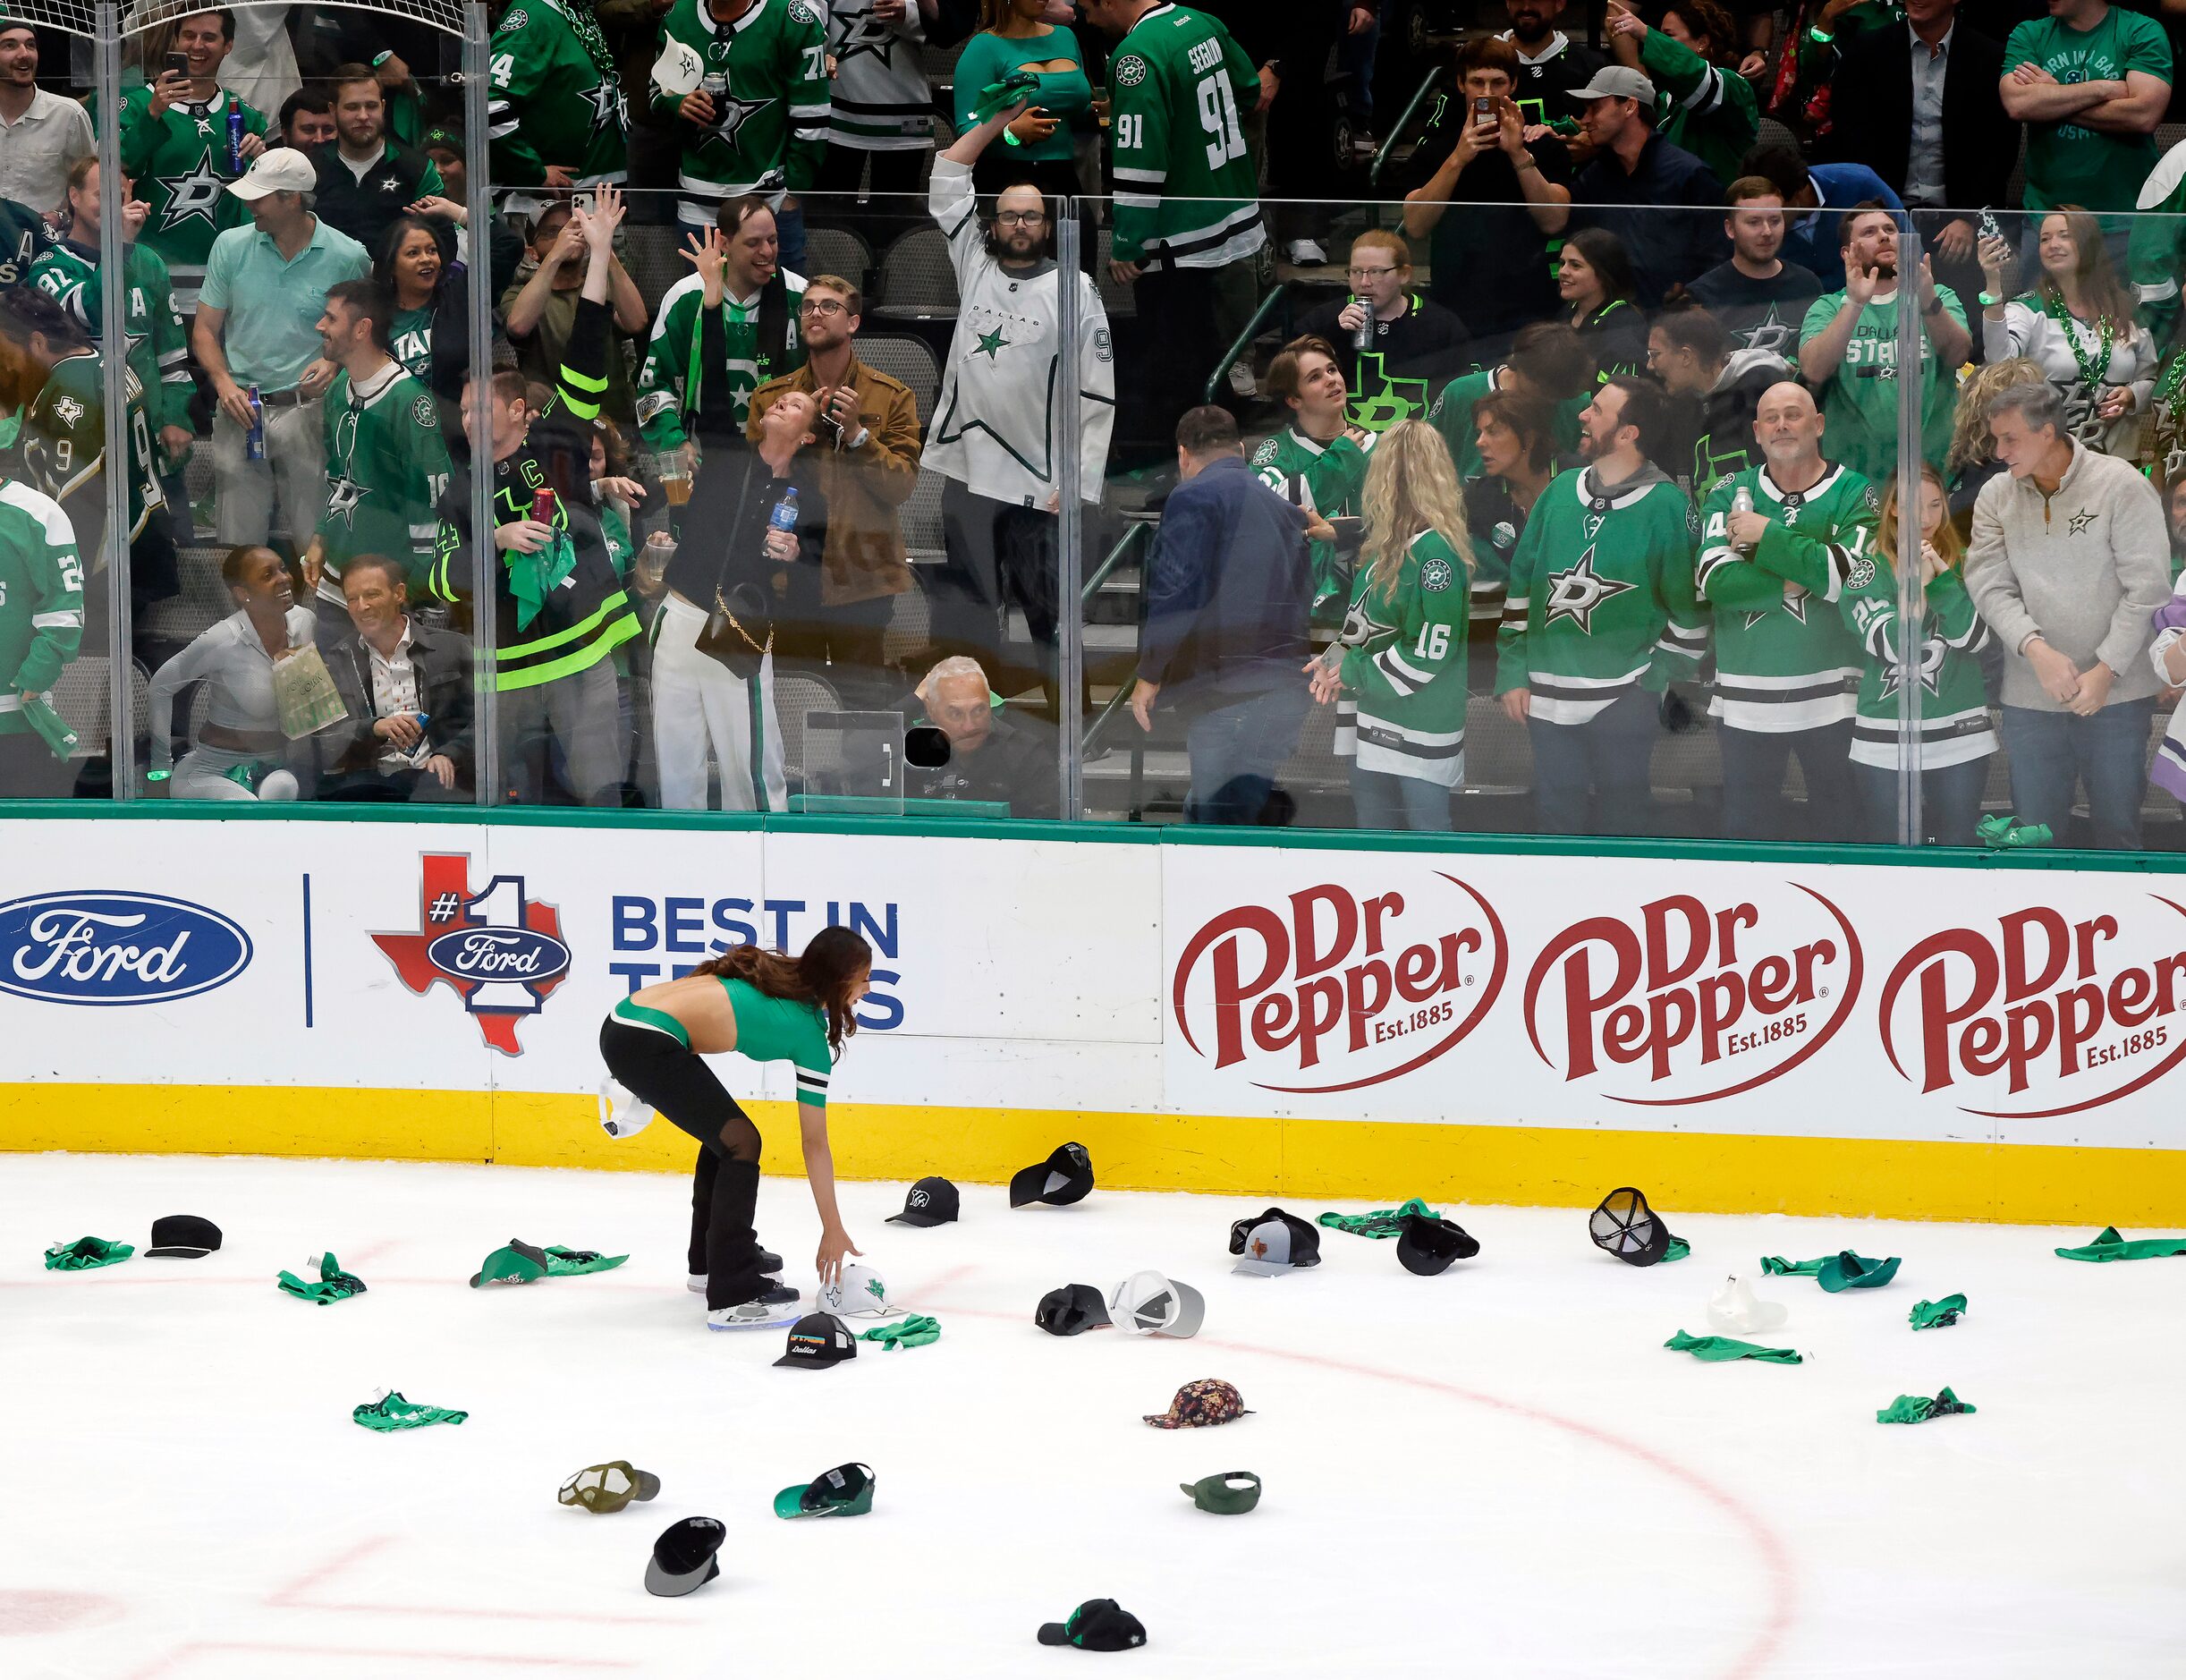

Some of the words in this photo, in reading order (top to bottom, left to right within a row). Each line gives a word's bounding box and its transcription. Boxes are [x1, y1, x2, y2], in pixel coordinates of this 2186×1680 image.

[801, 45, 827, 81] 71
[1187, 36, 1224, 75] SEGUIN
[1117, 114, 1143, 149] 91
[1197, 68, 1247, 171] 91
[2057, 124, 2099, 140] USM
[130, 287, 147, 318] A
[972, 305, 1040, 327] DALLAS
[1094, 327, 1114, 362] 9
[55, 438, 72, 472] 9
[135, 407, 165, 510] 9
[520, 459, 545, 489] C
[436, 517, 461, 553] 4
[57, 555, 85, 592] 2
[1414, 621, 1452, 660] 16
[612, 895, 806, 955] BEST
[1288, 883, 1405, 981] Dr
[1640, 894, 1758, 993] Dr
[13, 909, 191, 982] Ford
[454, 936, 541, 973] Ford
[1997, 906, 2119, 1005] Dr
[1173, 904, 1483, 1070] Pepper
[1523, 916, 1837, 1082] Pepper
[1878, 928, 2186, 1095] Pepper
[791, 1345, 818, 1355] Dallas
